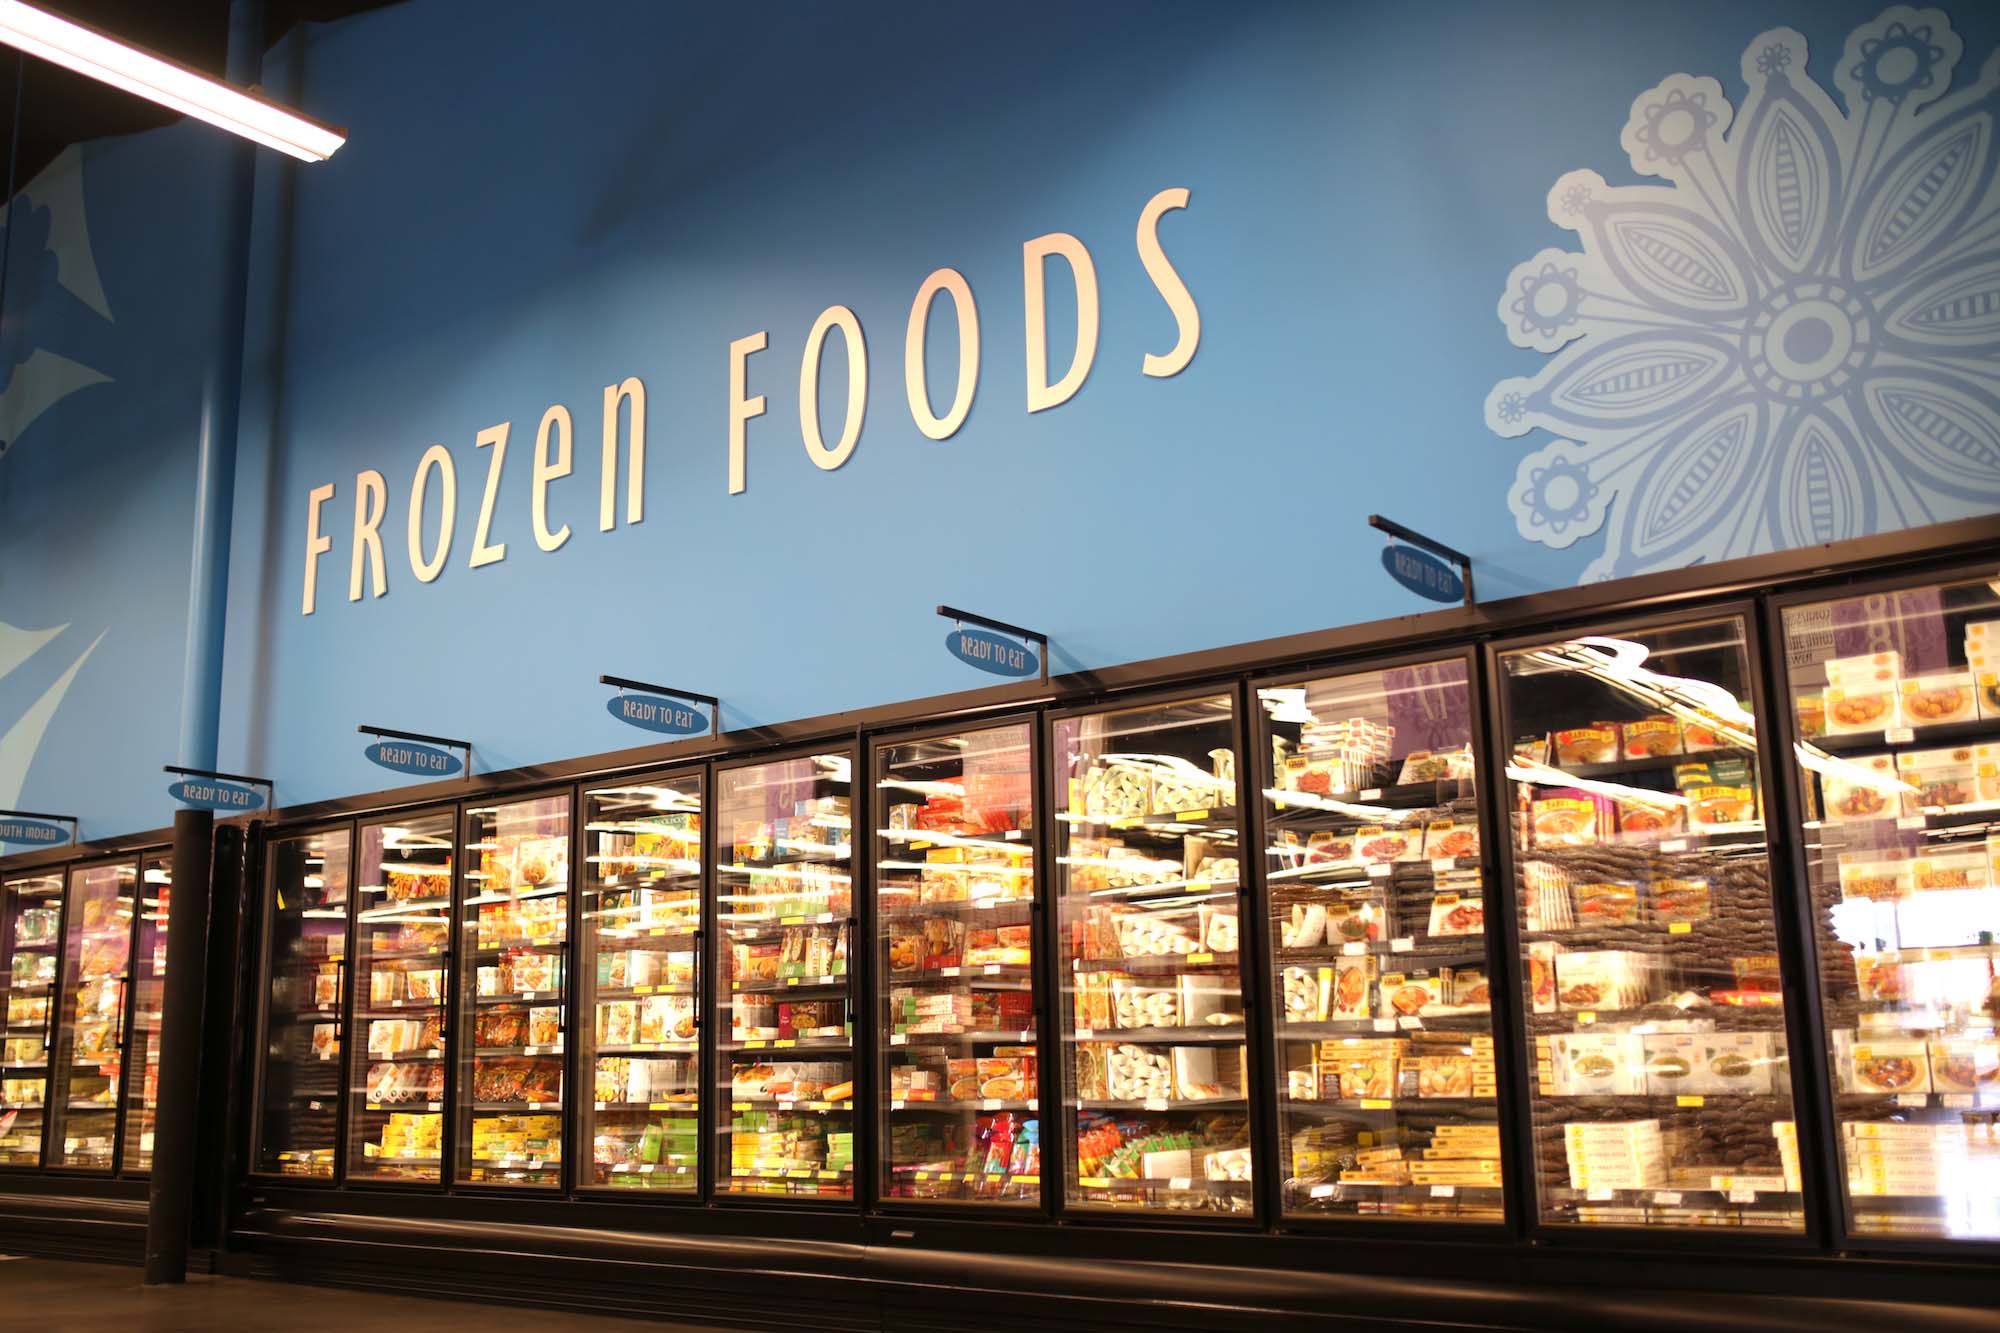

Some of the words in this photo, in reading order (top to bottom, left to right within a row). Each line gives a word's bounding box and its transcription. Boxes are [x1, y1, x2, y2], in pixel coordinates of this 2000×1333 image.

[728, 187, 1202, 496] FOODS
[994, 644, 1006, 665] TO
[660, 706, 672, 724] TO
[415, 751, 427, 768] TO
[218, 788, 230, 803] TO
